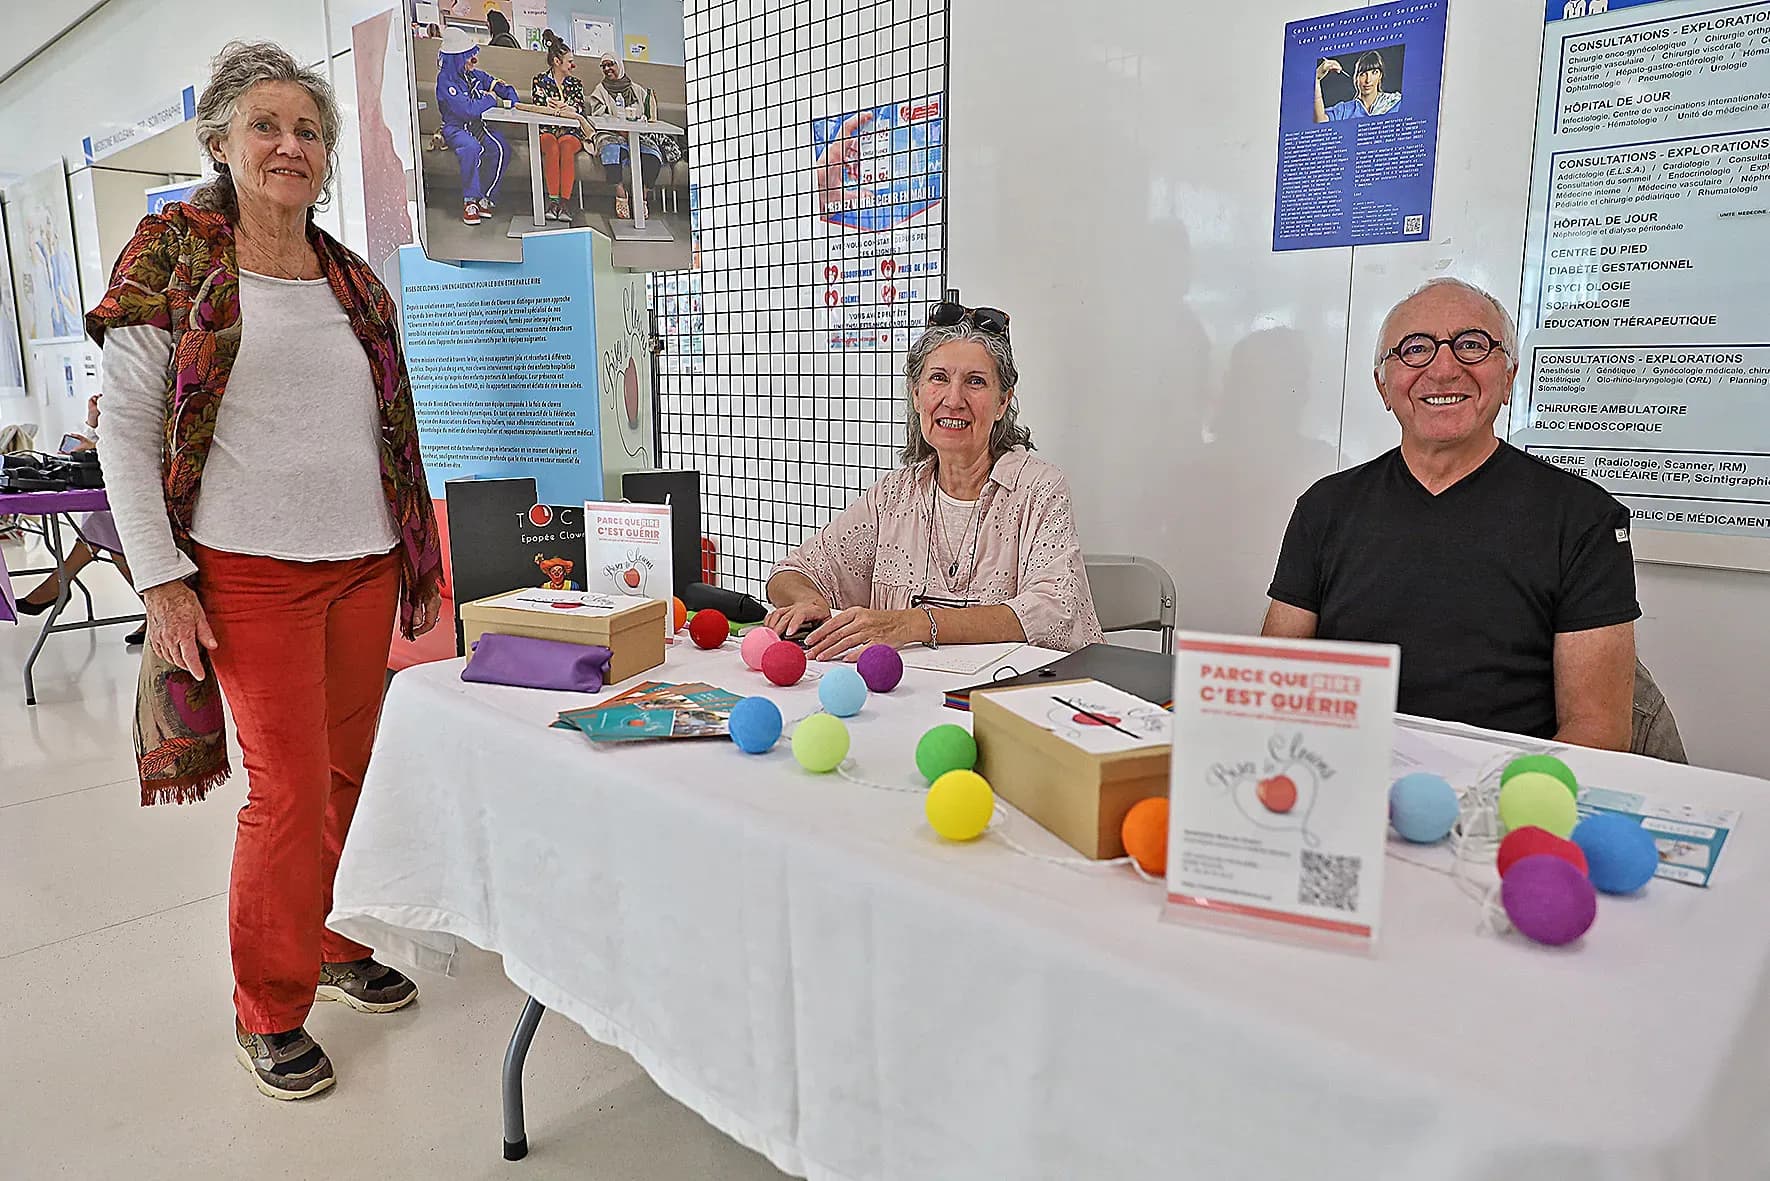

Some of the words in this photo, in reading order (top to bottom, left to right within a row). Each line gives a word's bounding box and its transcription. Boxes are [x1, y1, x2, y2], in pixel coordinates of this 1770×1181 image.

[1568, 53, 1602, 65] Chirurgie
[1604, 41, 1686, 59] onco-gynécologique
[1704, 31, 1744, 44] Chirurgie
[1569, 27, 1669, 54] CONSULTATIONS
[1567, 62, 1600, 74] Chirurgie
[1604, 56, 1644, 68] vasculaire
[1661, 47, 1699, 60] Chirurgie
[1702, 41, 1741, 53] viscérale
[1565, 79, 1621, 94] Ophtalmologie
[1637, 68, 1692, 83] Pneumologie
[1710, 60, 1747, 72] Urologie
[1566, 72, 1599, 84] Gériatrie
[1563, 98, 1613, 113] HÔPITAL
[1616, 96, 1632, 107] DE
[1636, 91, 1670, 104] JOUR
[1561, 123, 1600, 134] Oncologie
[1607, 116, 1657, 128] Hématologie
[1677, 110, 1699, 120] Unité
[1702, 109, 1712, 117] de
[1715, 104, 1758, 115] médecine
[1562, 112, 1609, 124] Infectiologie,
[1612, 109, 1639, 118] Centre
[1654, 101, 1705, 113] vaccinations
[1558, 150, 1656, 169] CONSULTATIONS
[1667, 138, 1769, 158] EXPLORATIONS
[1557, 169, 1604, 180] Addictologie
[1662, 159, 1709, 170] Cardiologie
[1556, 179, 1603, 189] Consultation
[1617, 174, 1651, 184] sommeil
[1668, 168, 1730, 179] Endocrinologie
[1554, 199, 1588, 208] Pédiatrie
[1590, 197, 1597, 205] et
[1599, 195, 1632, 204] chirurgie
[1635, 192, 1680, 203] pédiatrique
[1697, 185, 1758, 196] Rhumatologie
[1555, 189, 1592, 199] Médecine
[1594, 188, 1620, 196] interne
[1637, 182, 1676, 192] Médecine
[1679, 179, 1722, 189] vasculaire
[1553, 217, 1602, 228] HÔPITAL
[1605, 215, 1620, 225] DE
[1624, 213, 1657, 224] JOUR
[1552, 228, 1597, 238] Néphrologie
[1599, 227, 1606, 235] et
[1608, 226, 1636, 234] dialyse
[1638, 223, 1683, 233] péritonéale
[1550, 247, 1596, 257] CENTRE
[1600, 246, 1616, 255] DU
[1619, 244, 1647, 254] PIED
[1549, 263, 1597, 275] DIABÈTE
[1601, 260, 1693, 273] GESTATIONNEL
[1544, 318, 1609, 328] EDUCATION
[1612, 316, 1716, 327] THÉRAPEUTIQUE
[1540, 354, 1635, 364] CONSULTATIONS
[1645, 353, 1742, 363] EXPLORATIONS
[1596, 366, 1635, 375] Génétique
[1652, 366, 1702, 375] Gynécologie
[1705, 366, 1746, 374] médicale,
[1538, 376, 1580, 384] Obstétrique
[1685, 376, 1711, 385] (ORL)
[1729, 376, 1767, 385] Planning
[1537, 384, 1585, 393] Stomatologie
[1536, 403, 1597, 413] CHIRURGIE
[1599, 404, 1686, 414] AMBULATOIRE
[1535, 420, 1565, 429] BLOC
[1568, 421, 1662, 432] ENDOSCOPIQUE
[1594, 456, 1660, 469] (Radiologie,
[1664, 459, 1714, 471] Scanner,
[1718, 461, 1746, 472] IRM)
[1590, 468, 1658, 480] NUCLÉAIRE
[1661, 471, 1690, 483] (TEP,
[597, 516, 623, 525] PARCE
[624, 518, 641, 527] QUE
[1666, 512, 1683, 522] DE
[597, 527, 624, 537] C'EST
[626, 527, 660, 539] GUÉRIR
[1200, 664, 1264, 684] PARCE
[1269, 670, 1308, 689] QUE
[1200, 686, 1265, 709] C'EST
[1270, 691, 1359, 717] GUÉRIR
